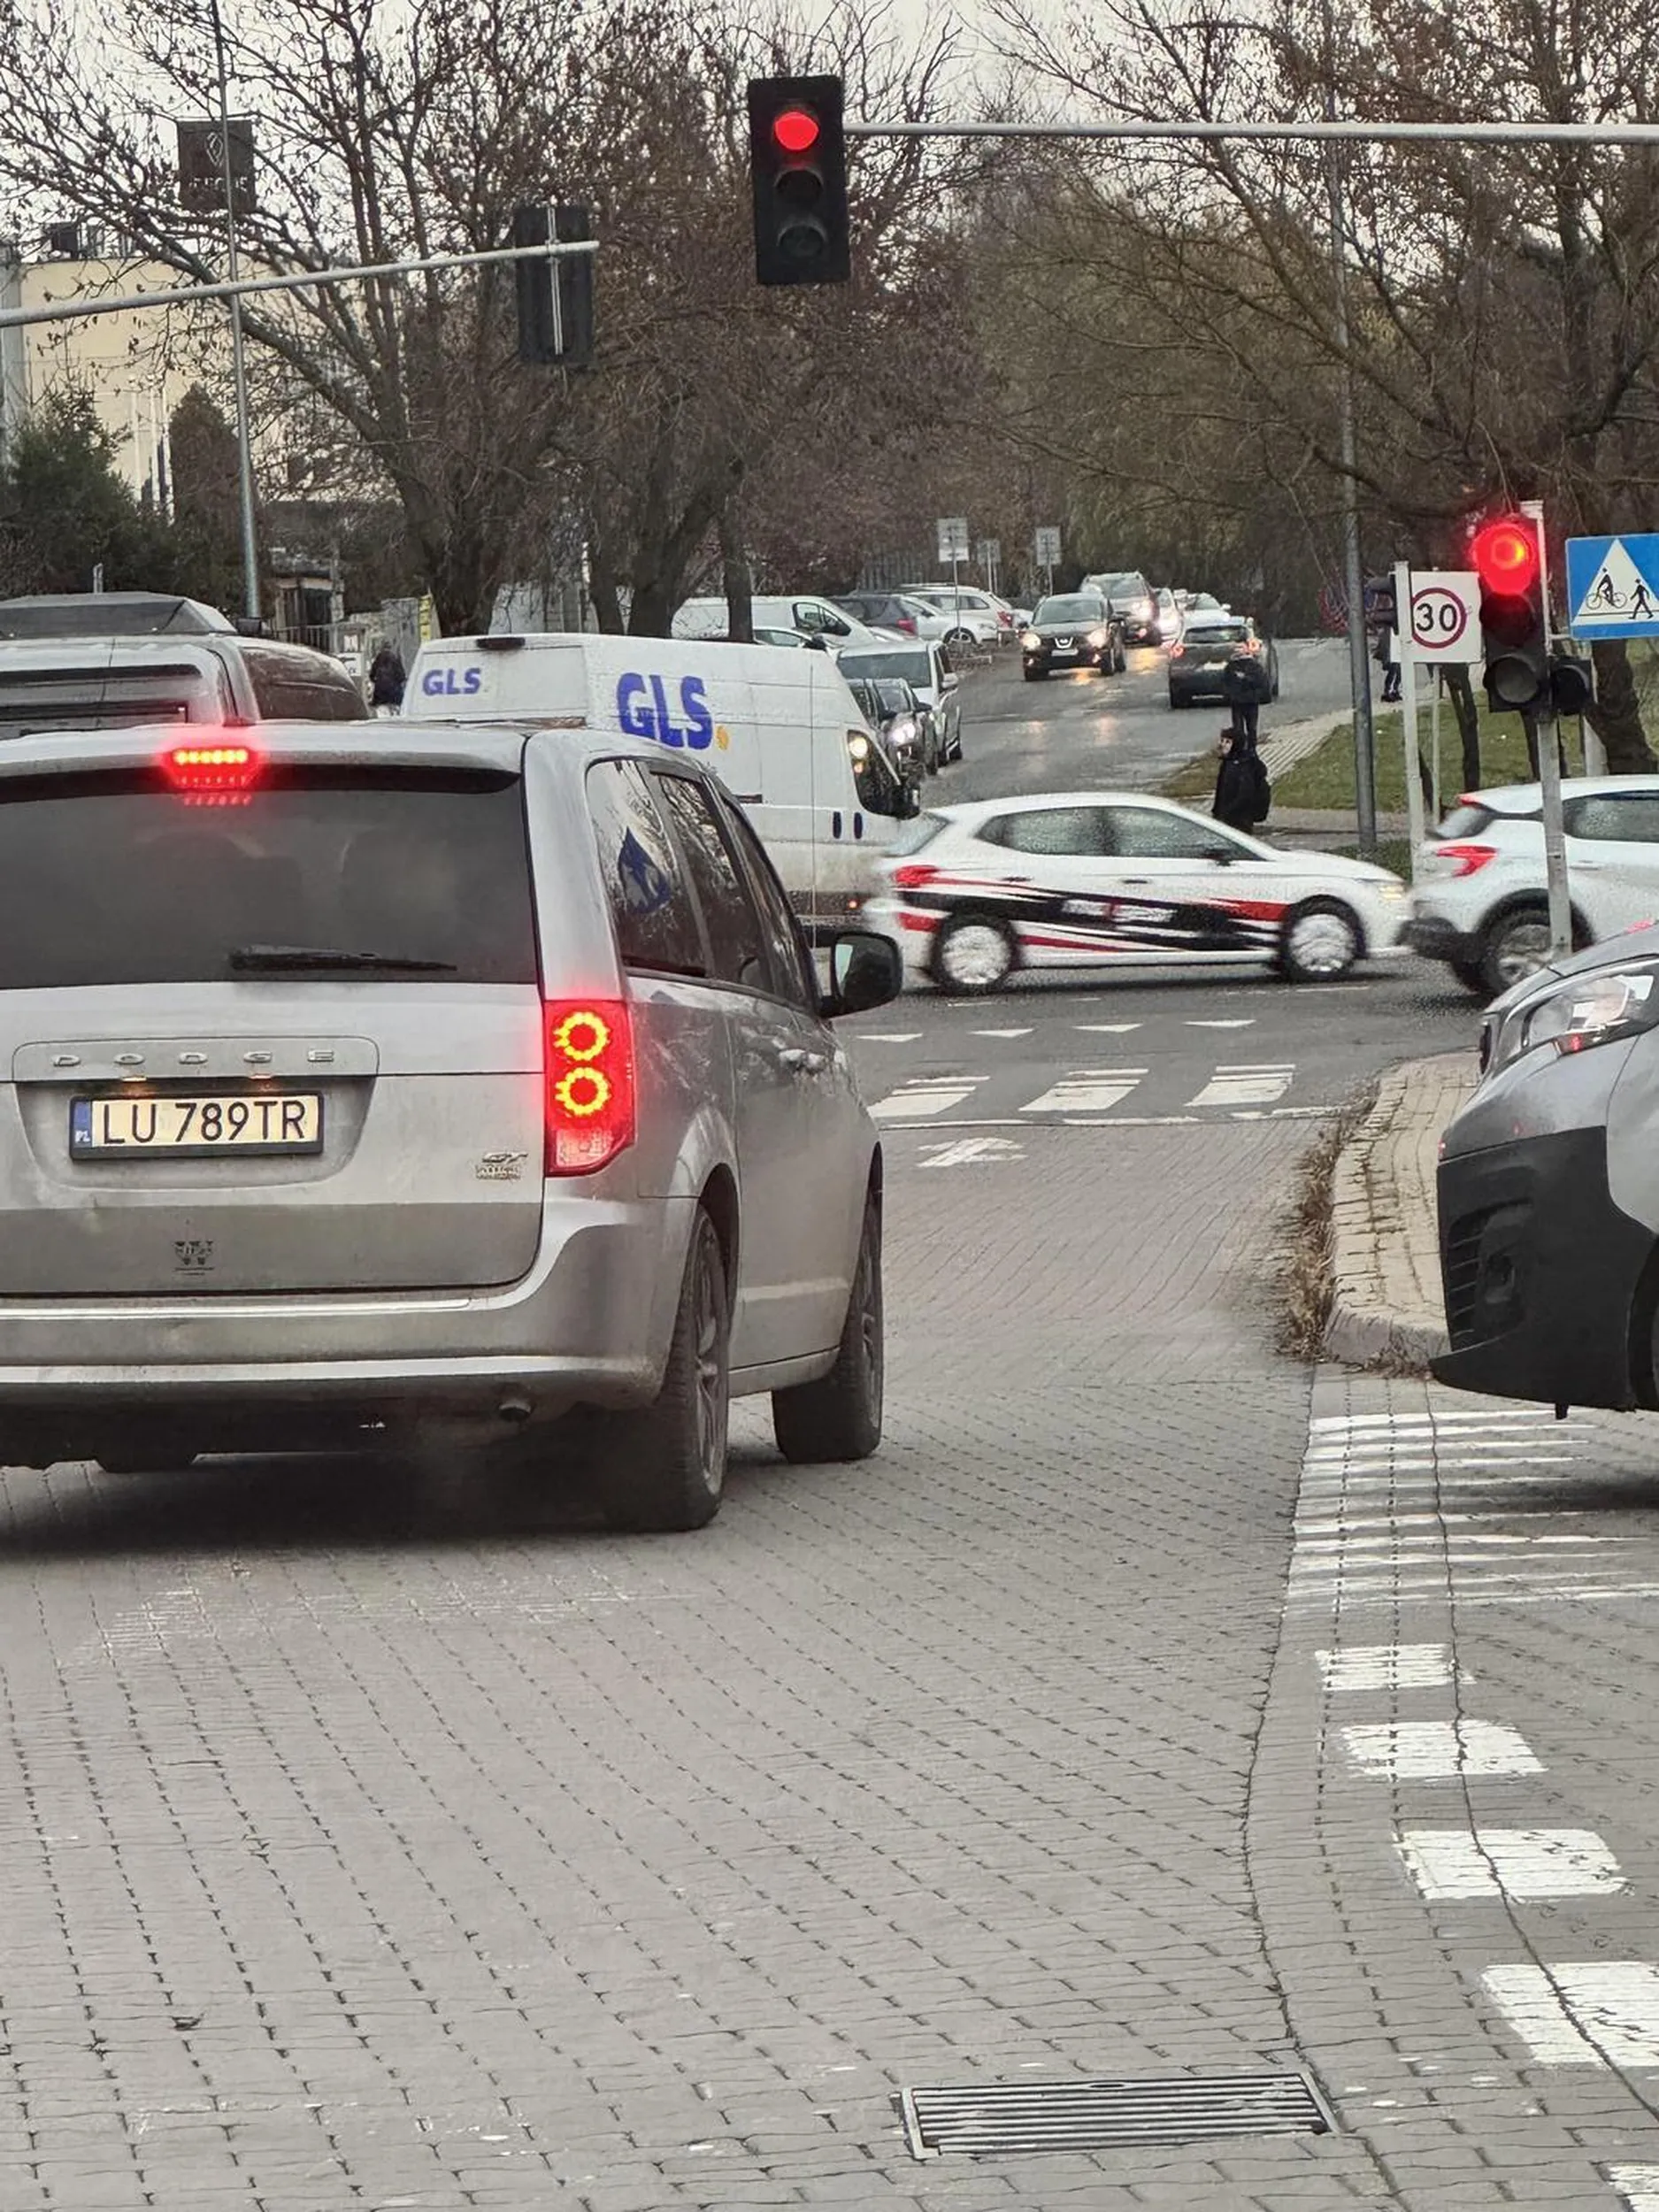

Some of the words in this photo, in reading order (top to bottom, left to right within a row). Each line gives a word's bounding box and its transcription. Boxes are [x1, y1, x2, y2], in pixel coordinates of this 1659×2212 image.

[1416, 603, 1458, 632] 30
[423, 667, 481, 696] GLS
[617, 672, 713, 749] GLS
[53, 1049, 334, 1067] DODGE
[103, 1103, 157, 1144] LU
[174, 1100, 306, 1142] 789TR
